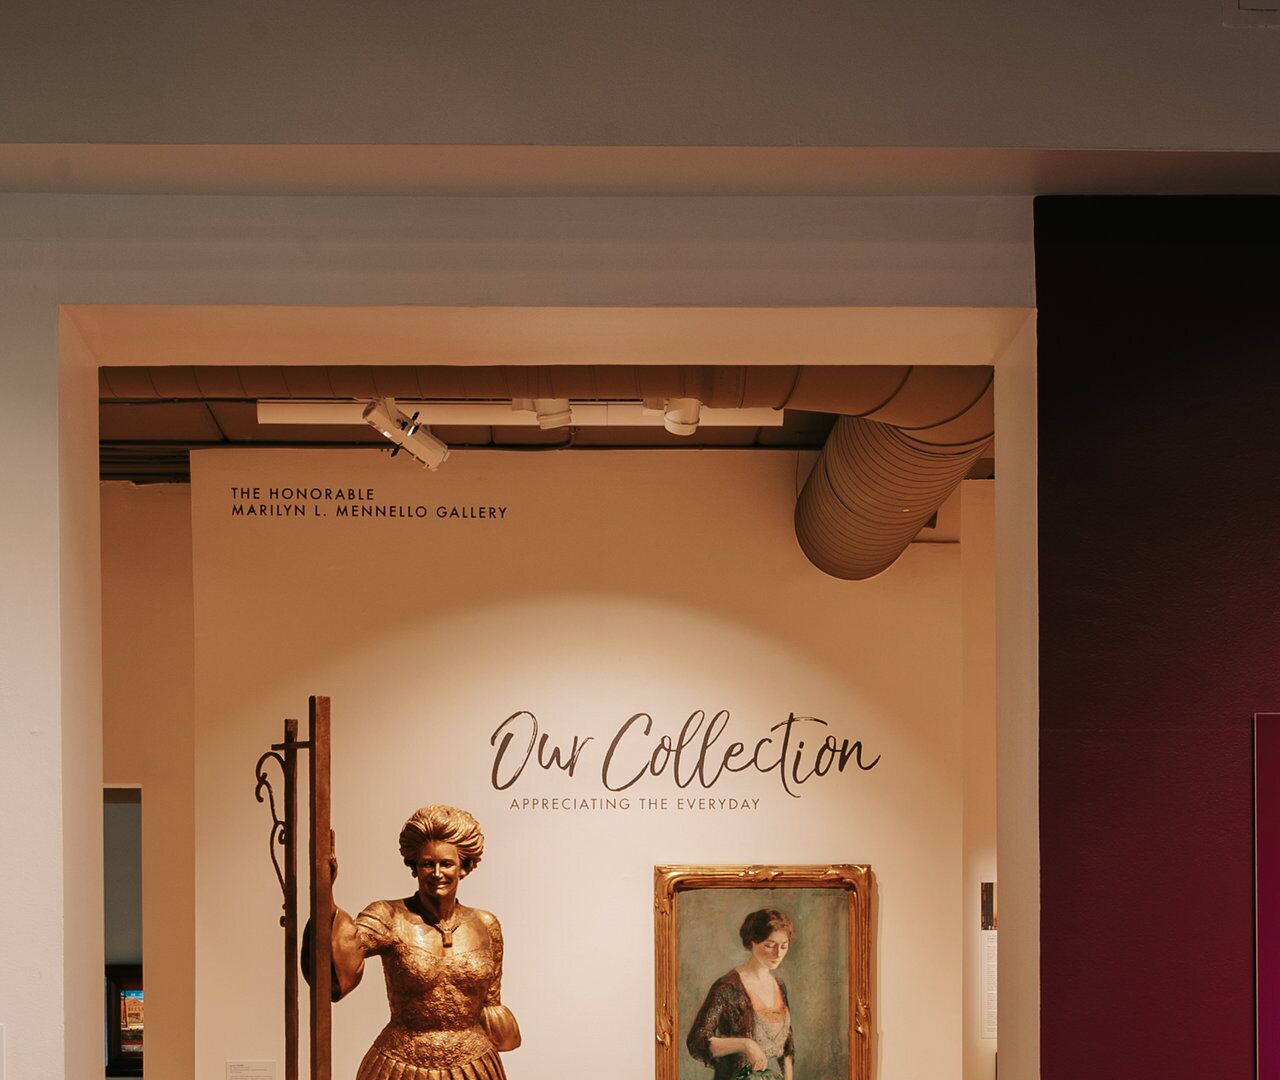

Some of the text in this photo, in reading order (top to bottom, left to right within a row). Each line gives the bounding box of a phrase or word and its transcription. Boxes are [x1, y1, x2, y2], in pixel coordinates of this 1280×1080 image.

[231, 487, 374, 500] THE HONORABLE
[231, 504, 508, 519] MARILYN L. MENNELLO GALLERY
[490, 709, 881, 799] Our Collection
[509, 798, 760, 811] APPRECIATING THE EVERYDAY
